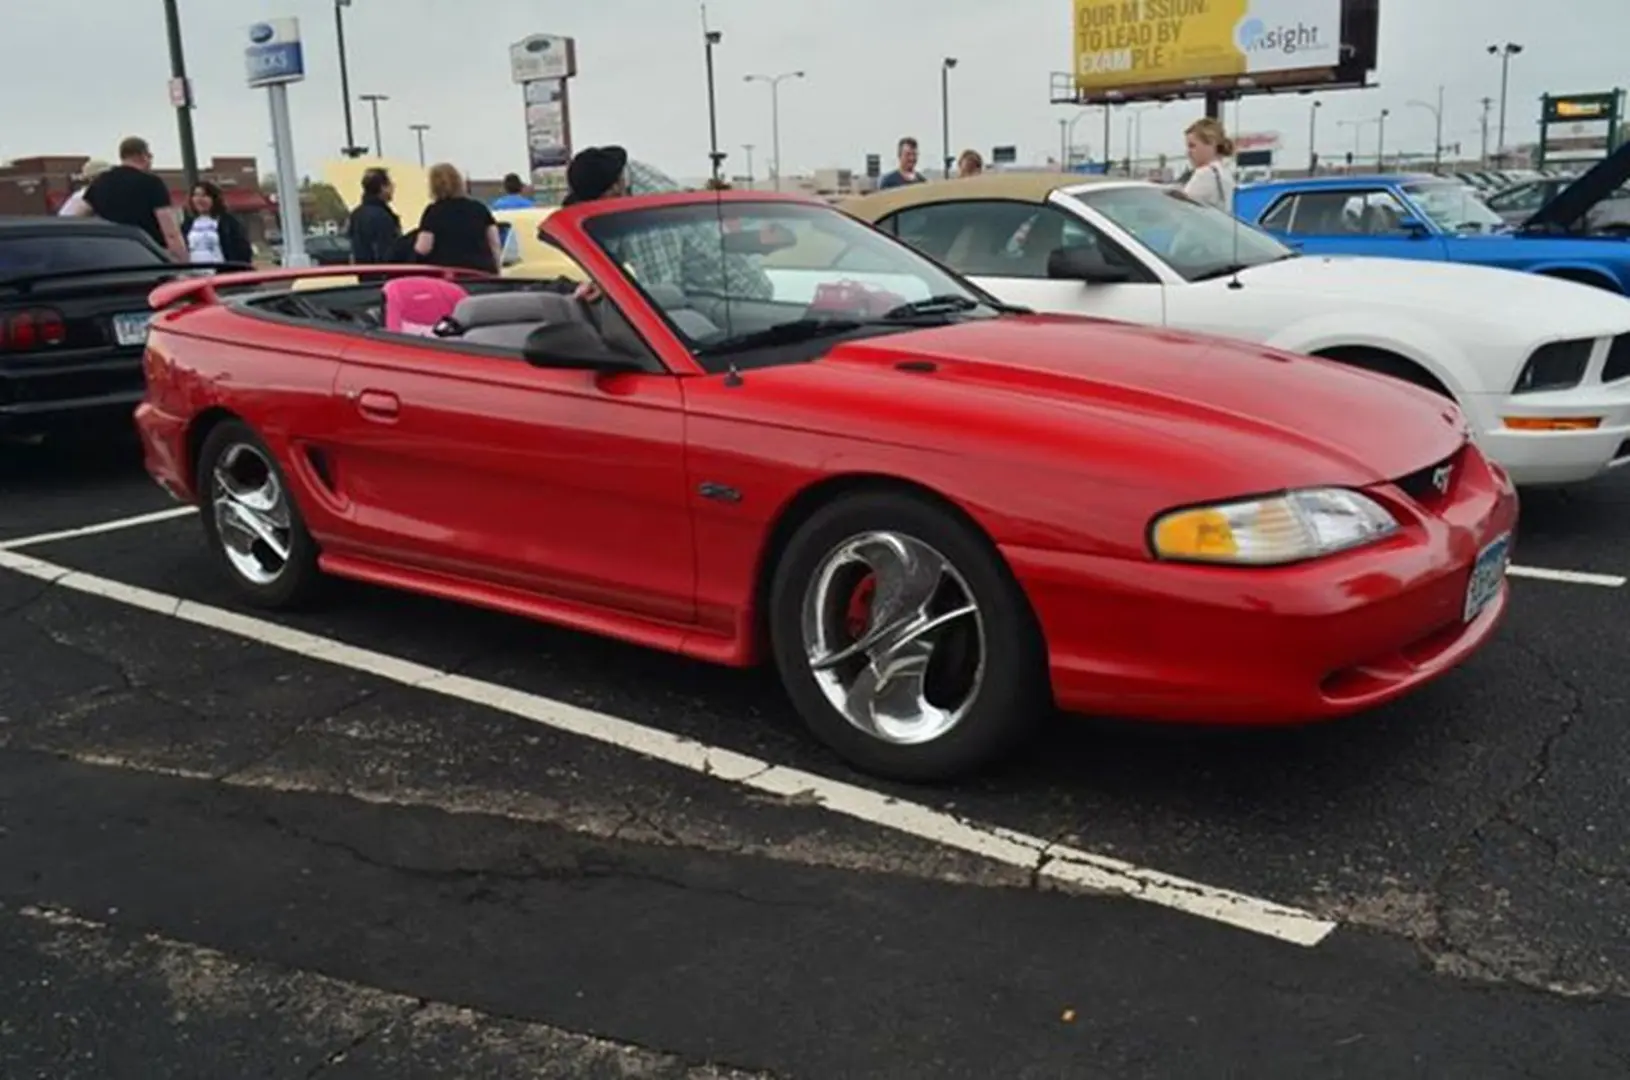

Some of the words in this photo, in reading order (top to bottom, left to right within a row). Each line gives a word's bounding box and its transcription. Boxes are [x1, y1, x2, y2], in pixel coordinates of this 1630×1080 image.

[1079, 4, 1116, 28] OUR
[1079, 30, 1102, 52] TO
[1106, 23, 1152, 49] LEAD
[1157, 20, 1183, 43] BY
